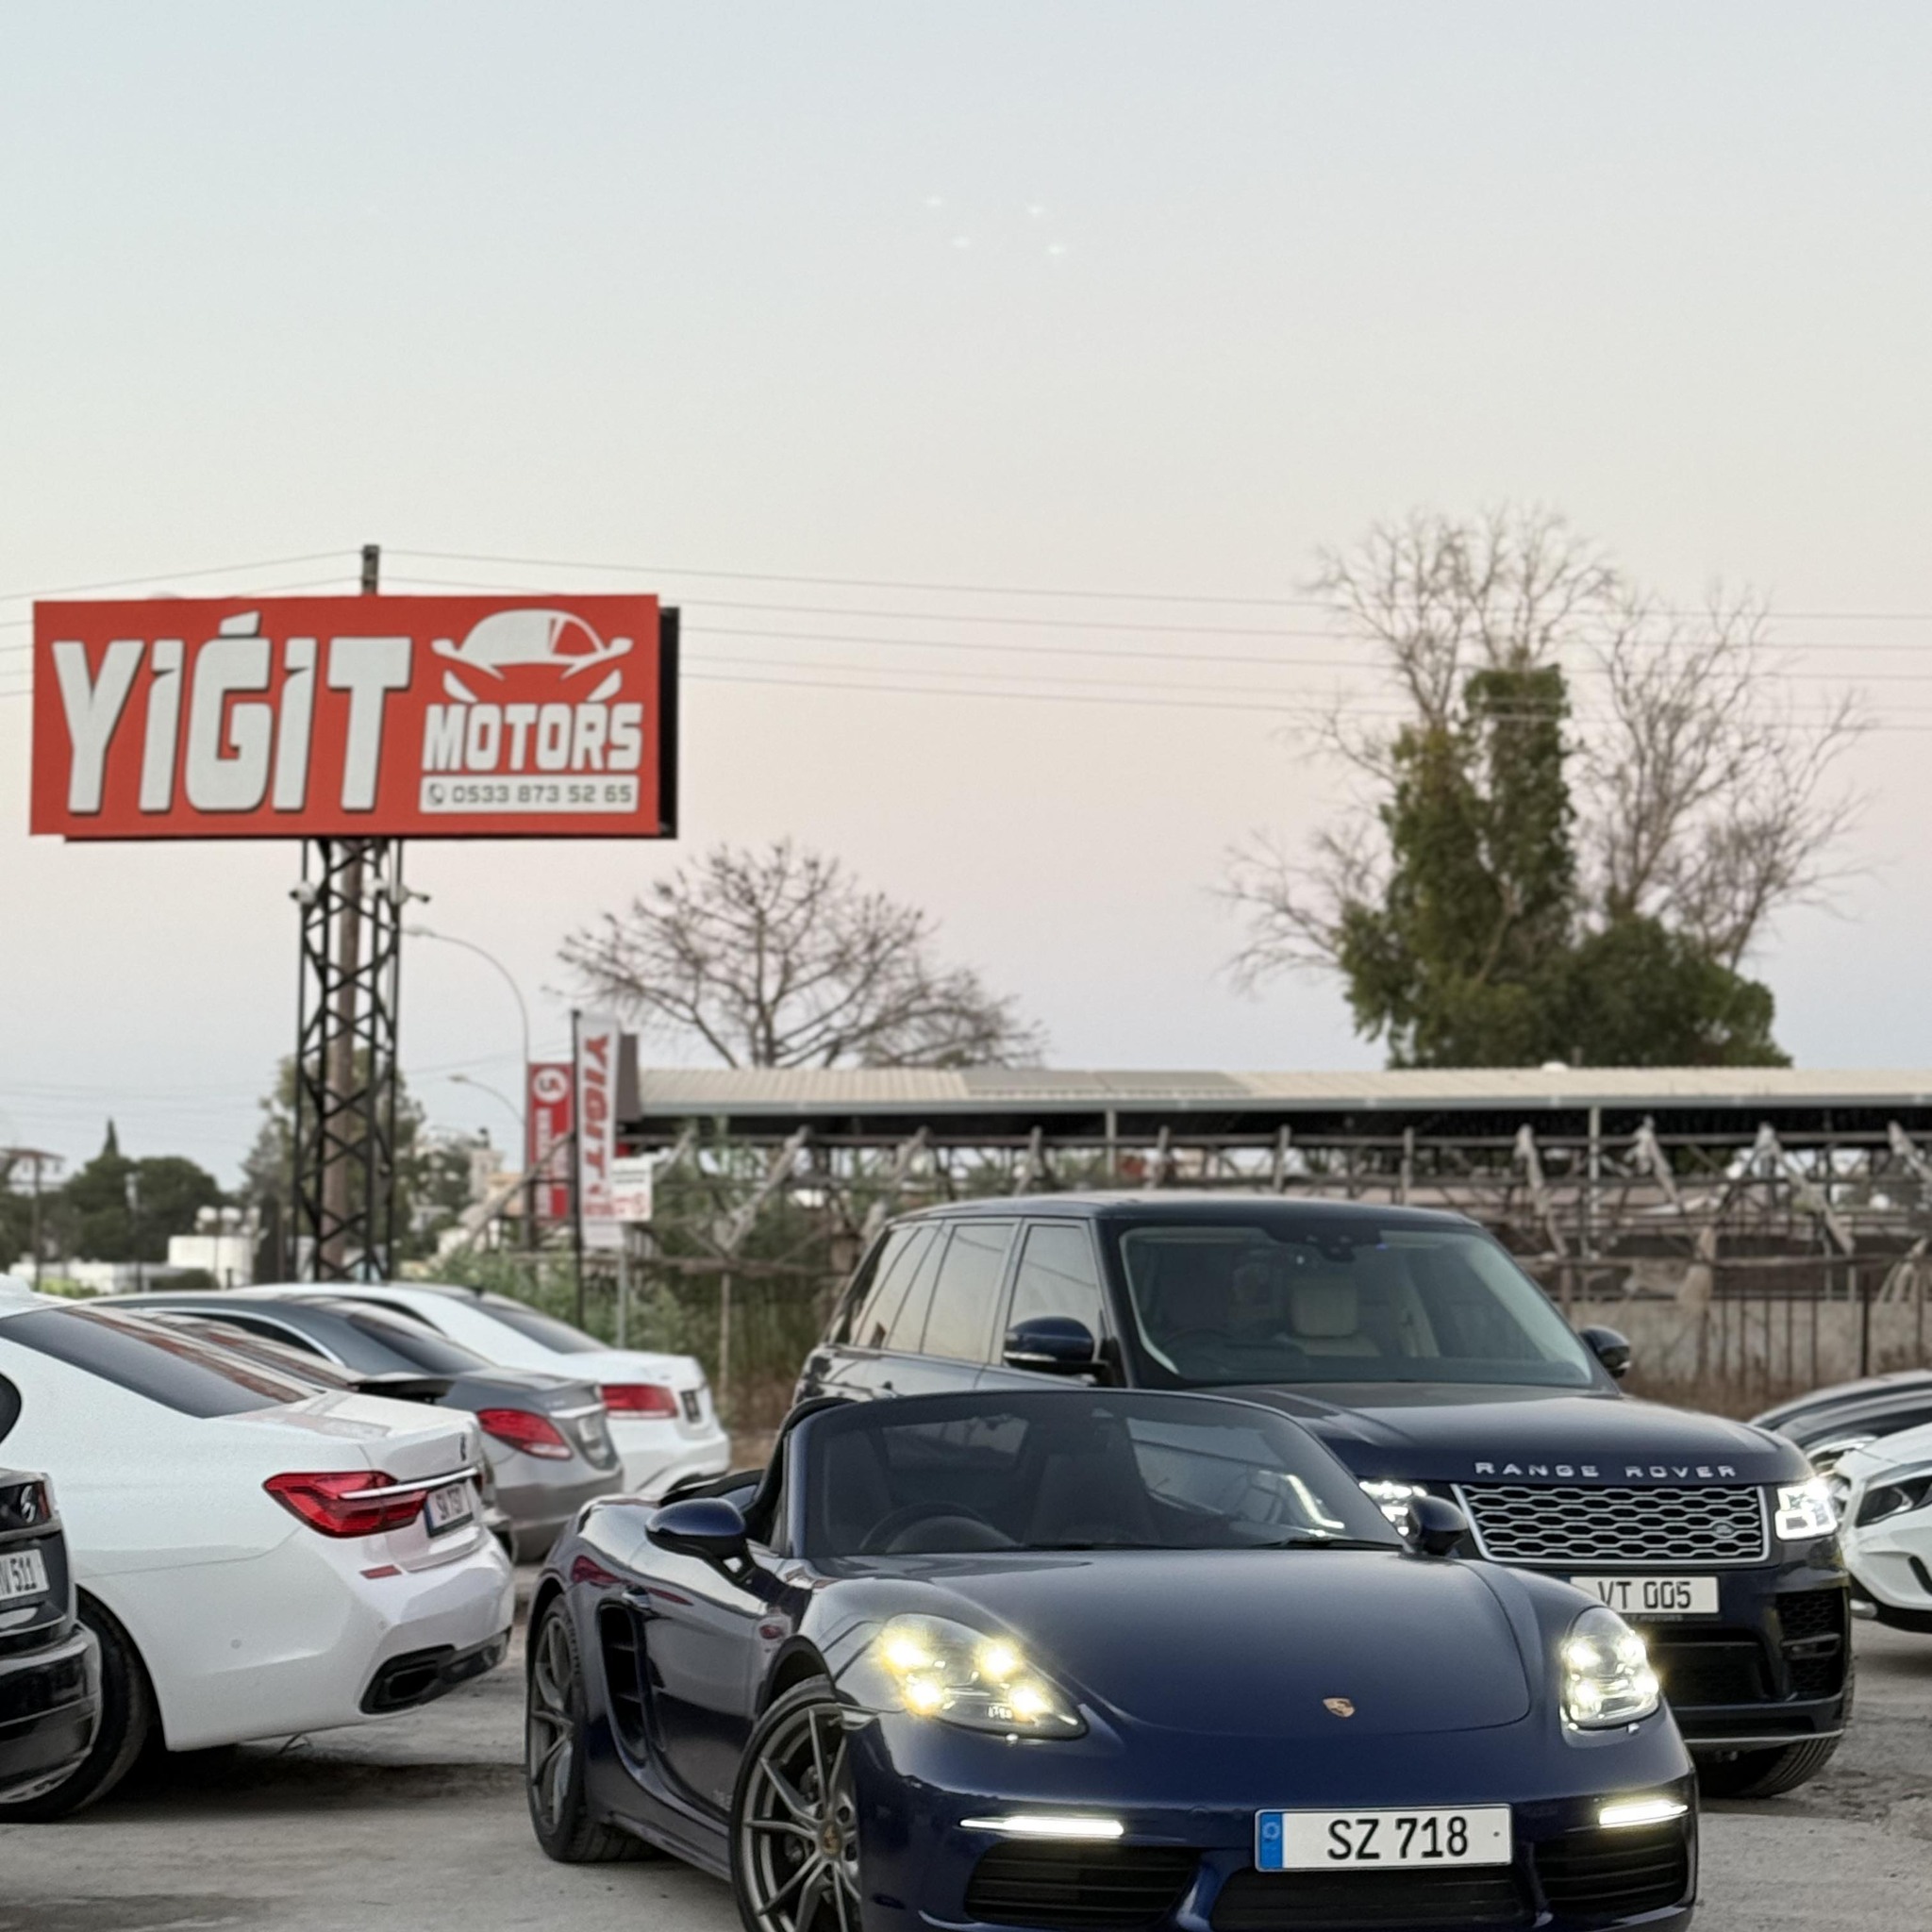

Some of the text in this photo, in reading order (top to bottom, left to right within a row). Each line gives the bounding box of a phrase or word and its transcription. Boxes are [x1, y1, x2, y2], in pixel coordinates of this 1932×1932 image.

[422, 703, 643, 772] MOTORS
[452, 784, 510, 804] 0533
[517, 784, 561, 804] 873
[567, 784, 596, 804] 52
[1474, 1461, 1737, 1478] RANGE ROVER
[1597, 1580, 1691, 1610] VT 005
[1326, 1816, 1469, 1861] SZ 718
